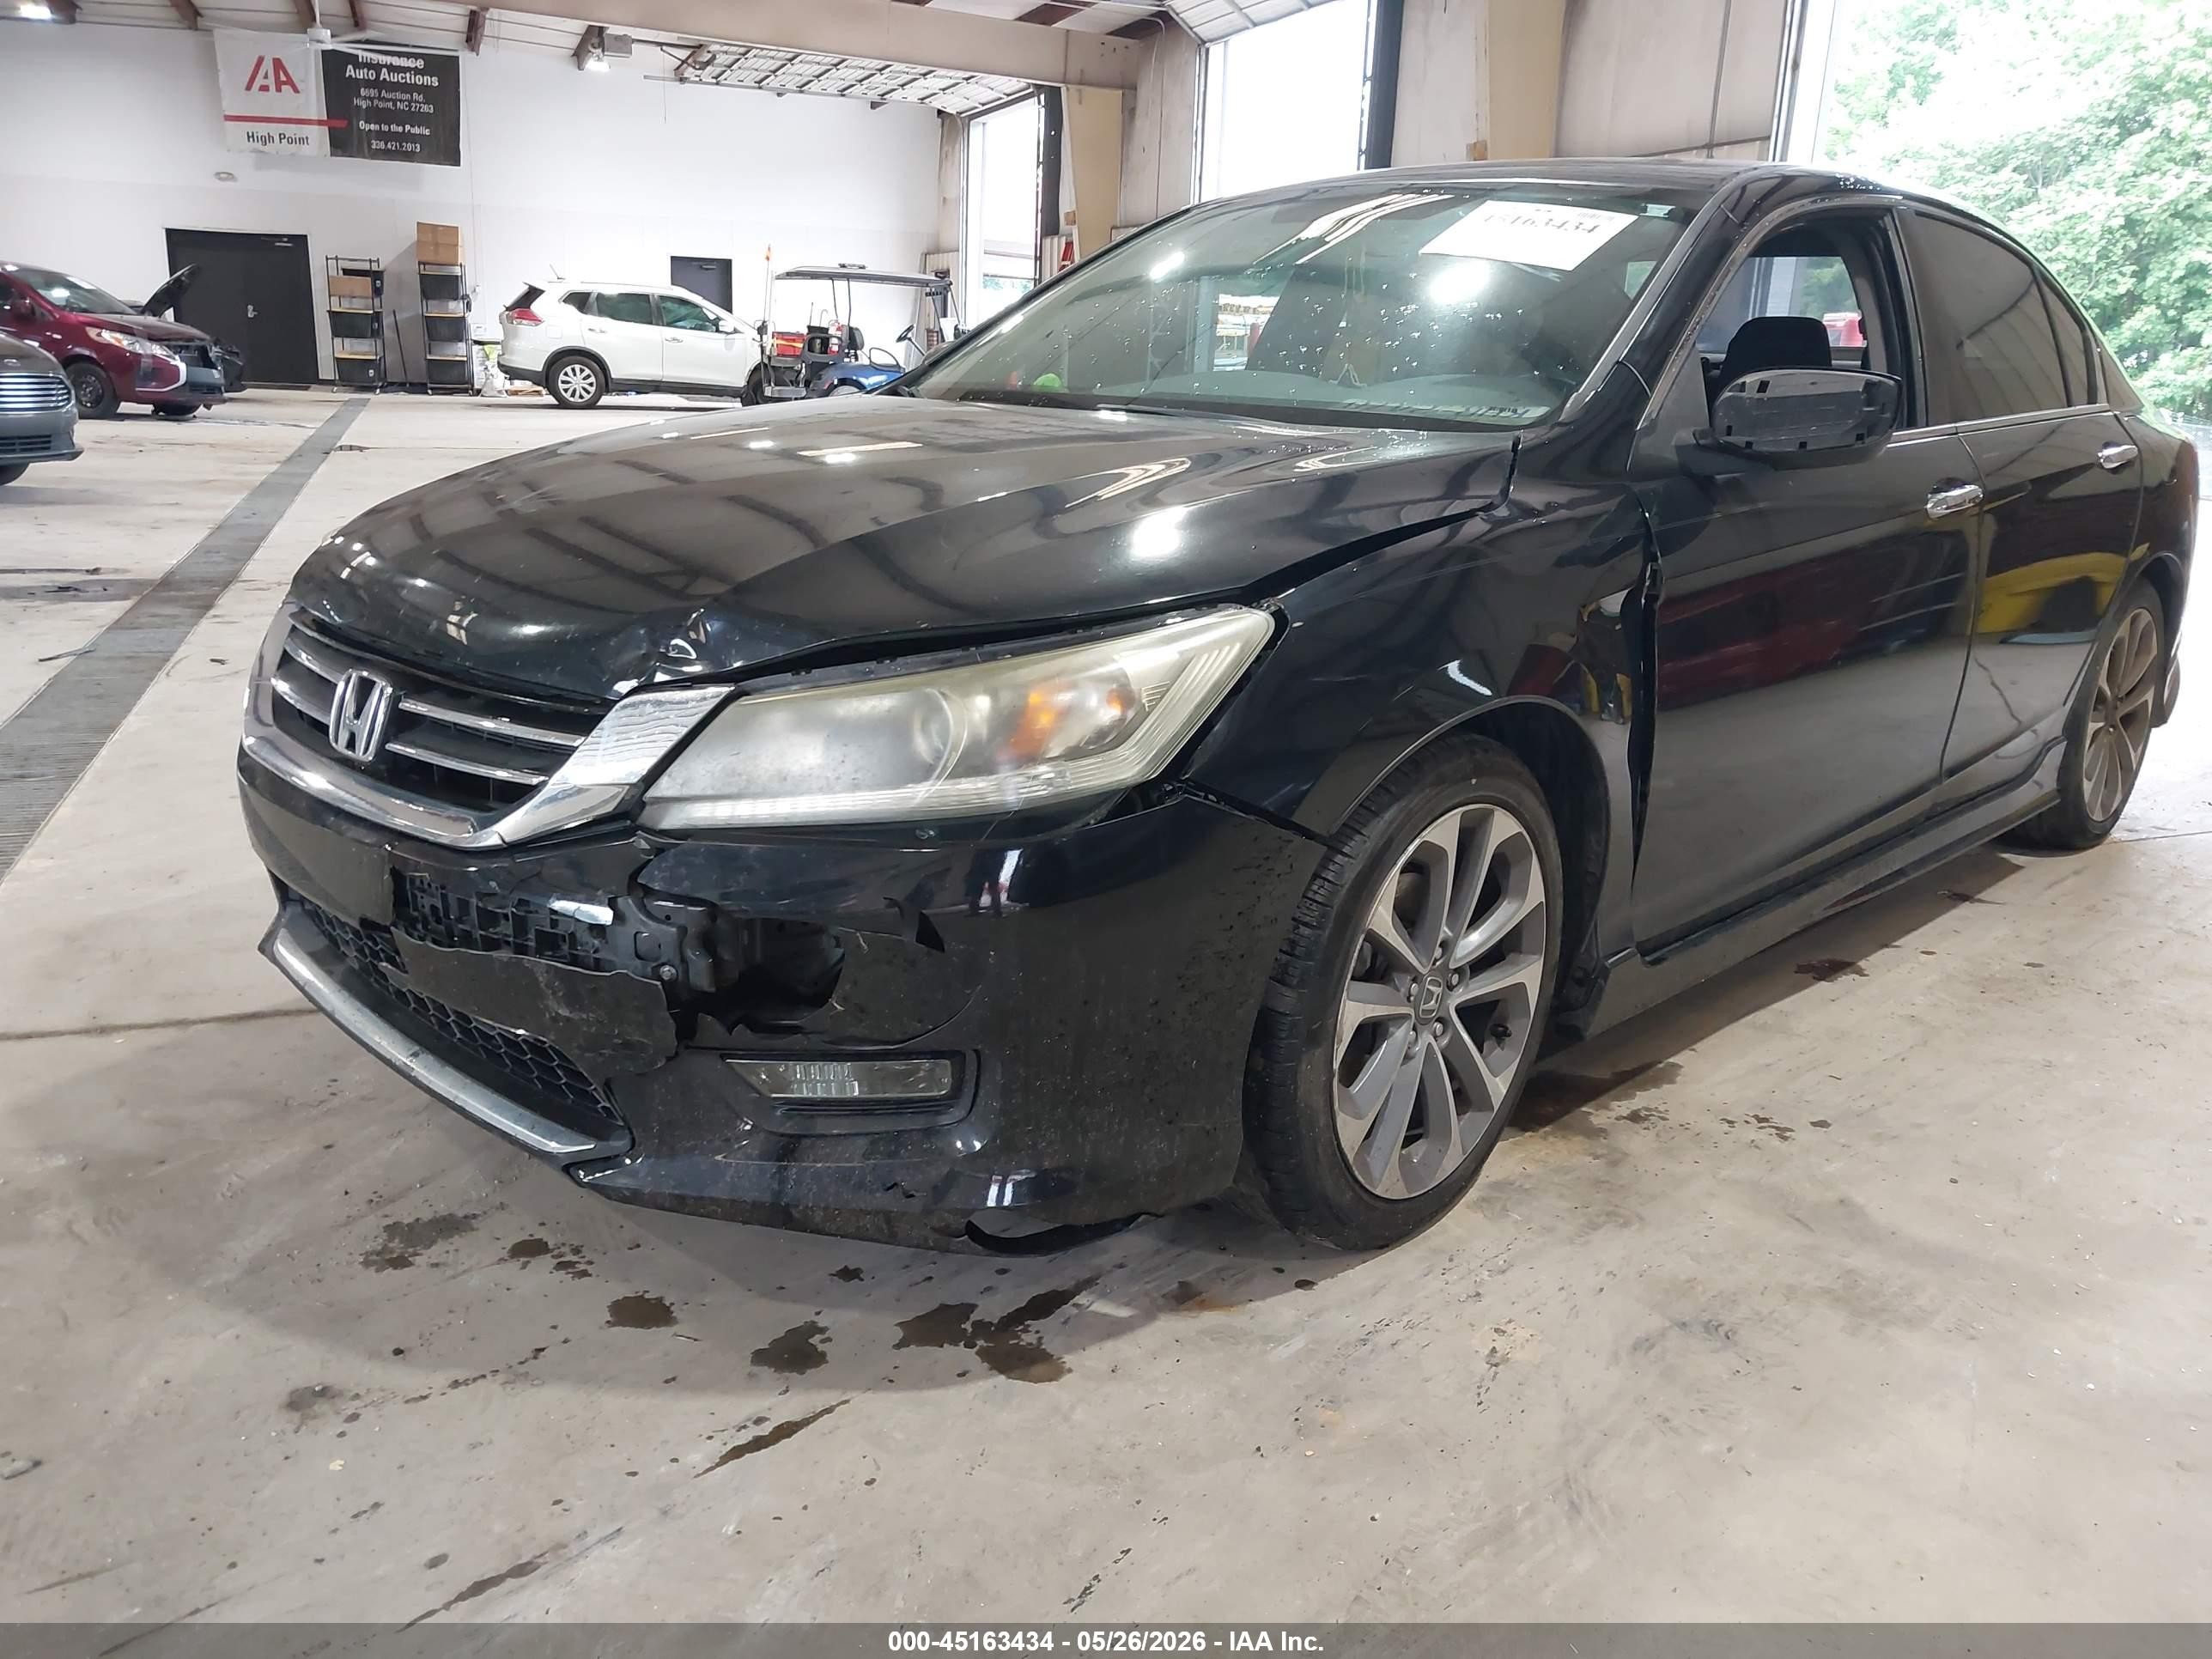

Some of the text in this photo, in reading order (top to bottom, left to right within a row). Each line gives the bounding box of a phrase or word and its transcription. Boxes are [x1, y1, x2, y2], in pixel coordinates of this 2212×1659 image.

[358, 52, 424, 69] Insurance
[345, 64, 439, 87] Auto Auctions
[381, 88, 410, 100] Auction
[413, 92, 426, 102] Rd.
[354, 97, 371, 109] High
[374, 99, 395, 111] Point,
[397, 101, 409, 111] NC
[359, 120, 430, 136] Open to the Public
[246, 131, 310, 146] High Point
